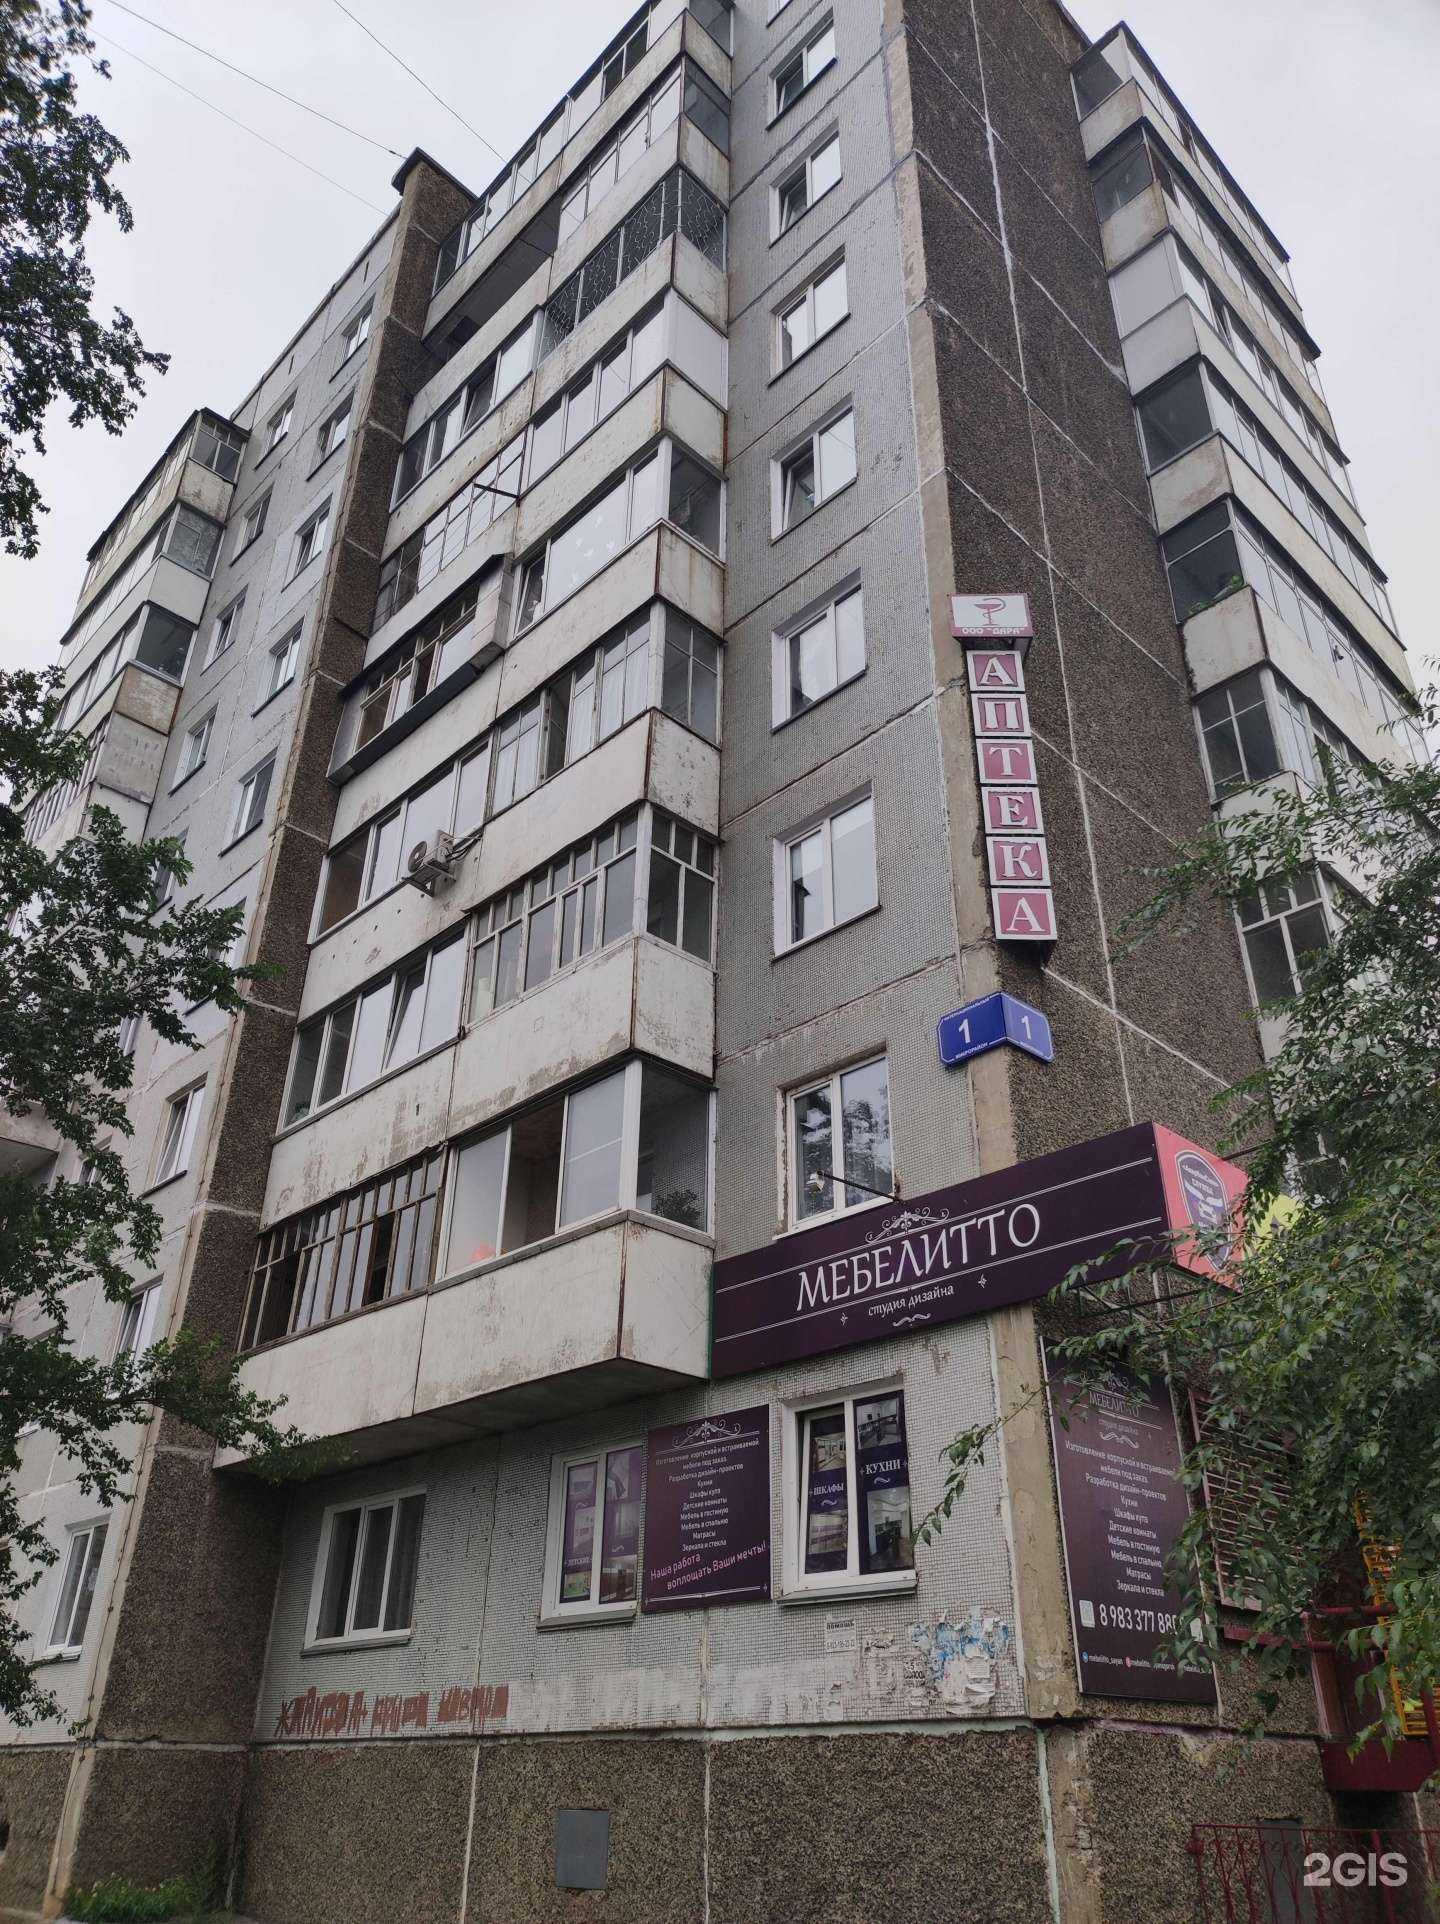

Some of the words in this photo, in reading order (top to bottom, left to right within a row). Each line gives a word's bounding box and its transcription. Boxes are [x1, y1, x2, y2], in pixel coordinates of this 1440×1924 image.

[961, 627, 984, 635] ООО
[980, 655, 1045, 932] АПТЕКА
[958, 1018, 971, 1044] 1
[1021, 1015, 1032, 1041] 1
[796, 1203, 1041, 1311] МЕБЕЛИТТО
[867, 1296, 907, 1318] студия
[907, 1282, 954, 1311] дизайна
[865, 1459, 901, 1475] КУХНИ
[813, 1482, 844, 1496] ШКАФЫ
[692, 1530, 716, 1540] Матрасы
[650, 1564, 672, 1580] Наша
[672, 1553, 701, 1574] работа
[667, 1565, 712, 1590] воплощать
[712, 1555, 736, 1572] Ваши
[736, 1540, 767, 1561] мечты!
[1126, 1566, 1152, 1581] Матрасы
[1099, 1603, 1108, 1626] 8
[1109, 1605, 1133, 1630] 983
[1134, 1609, 1155, 1633] 377
[1157, 1612, 1184, 1635] 885
